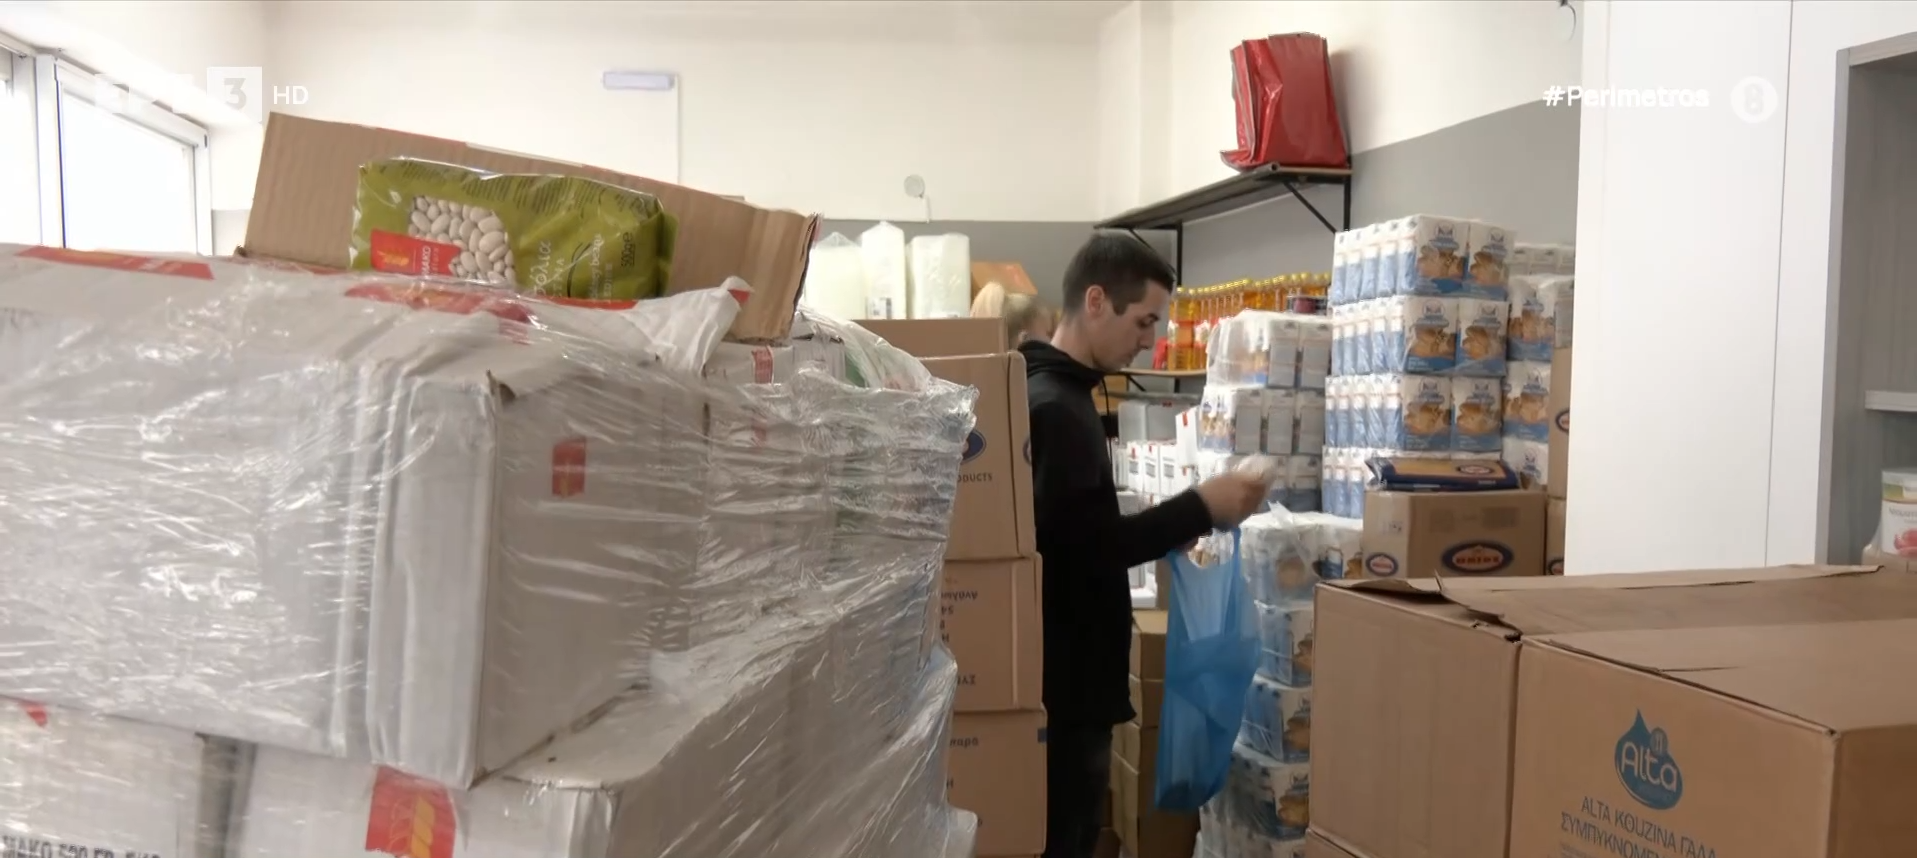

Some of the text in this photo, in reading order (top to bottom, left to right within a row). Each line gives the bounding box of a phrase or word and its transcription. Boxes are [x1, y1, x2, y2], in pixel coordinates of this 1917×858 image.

[1620, 741, 1678, 793] Alta
[1581, 796, 1611, 823] ALTA
[1614, 809, 1677, 853] KOUZINA
